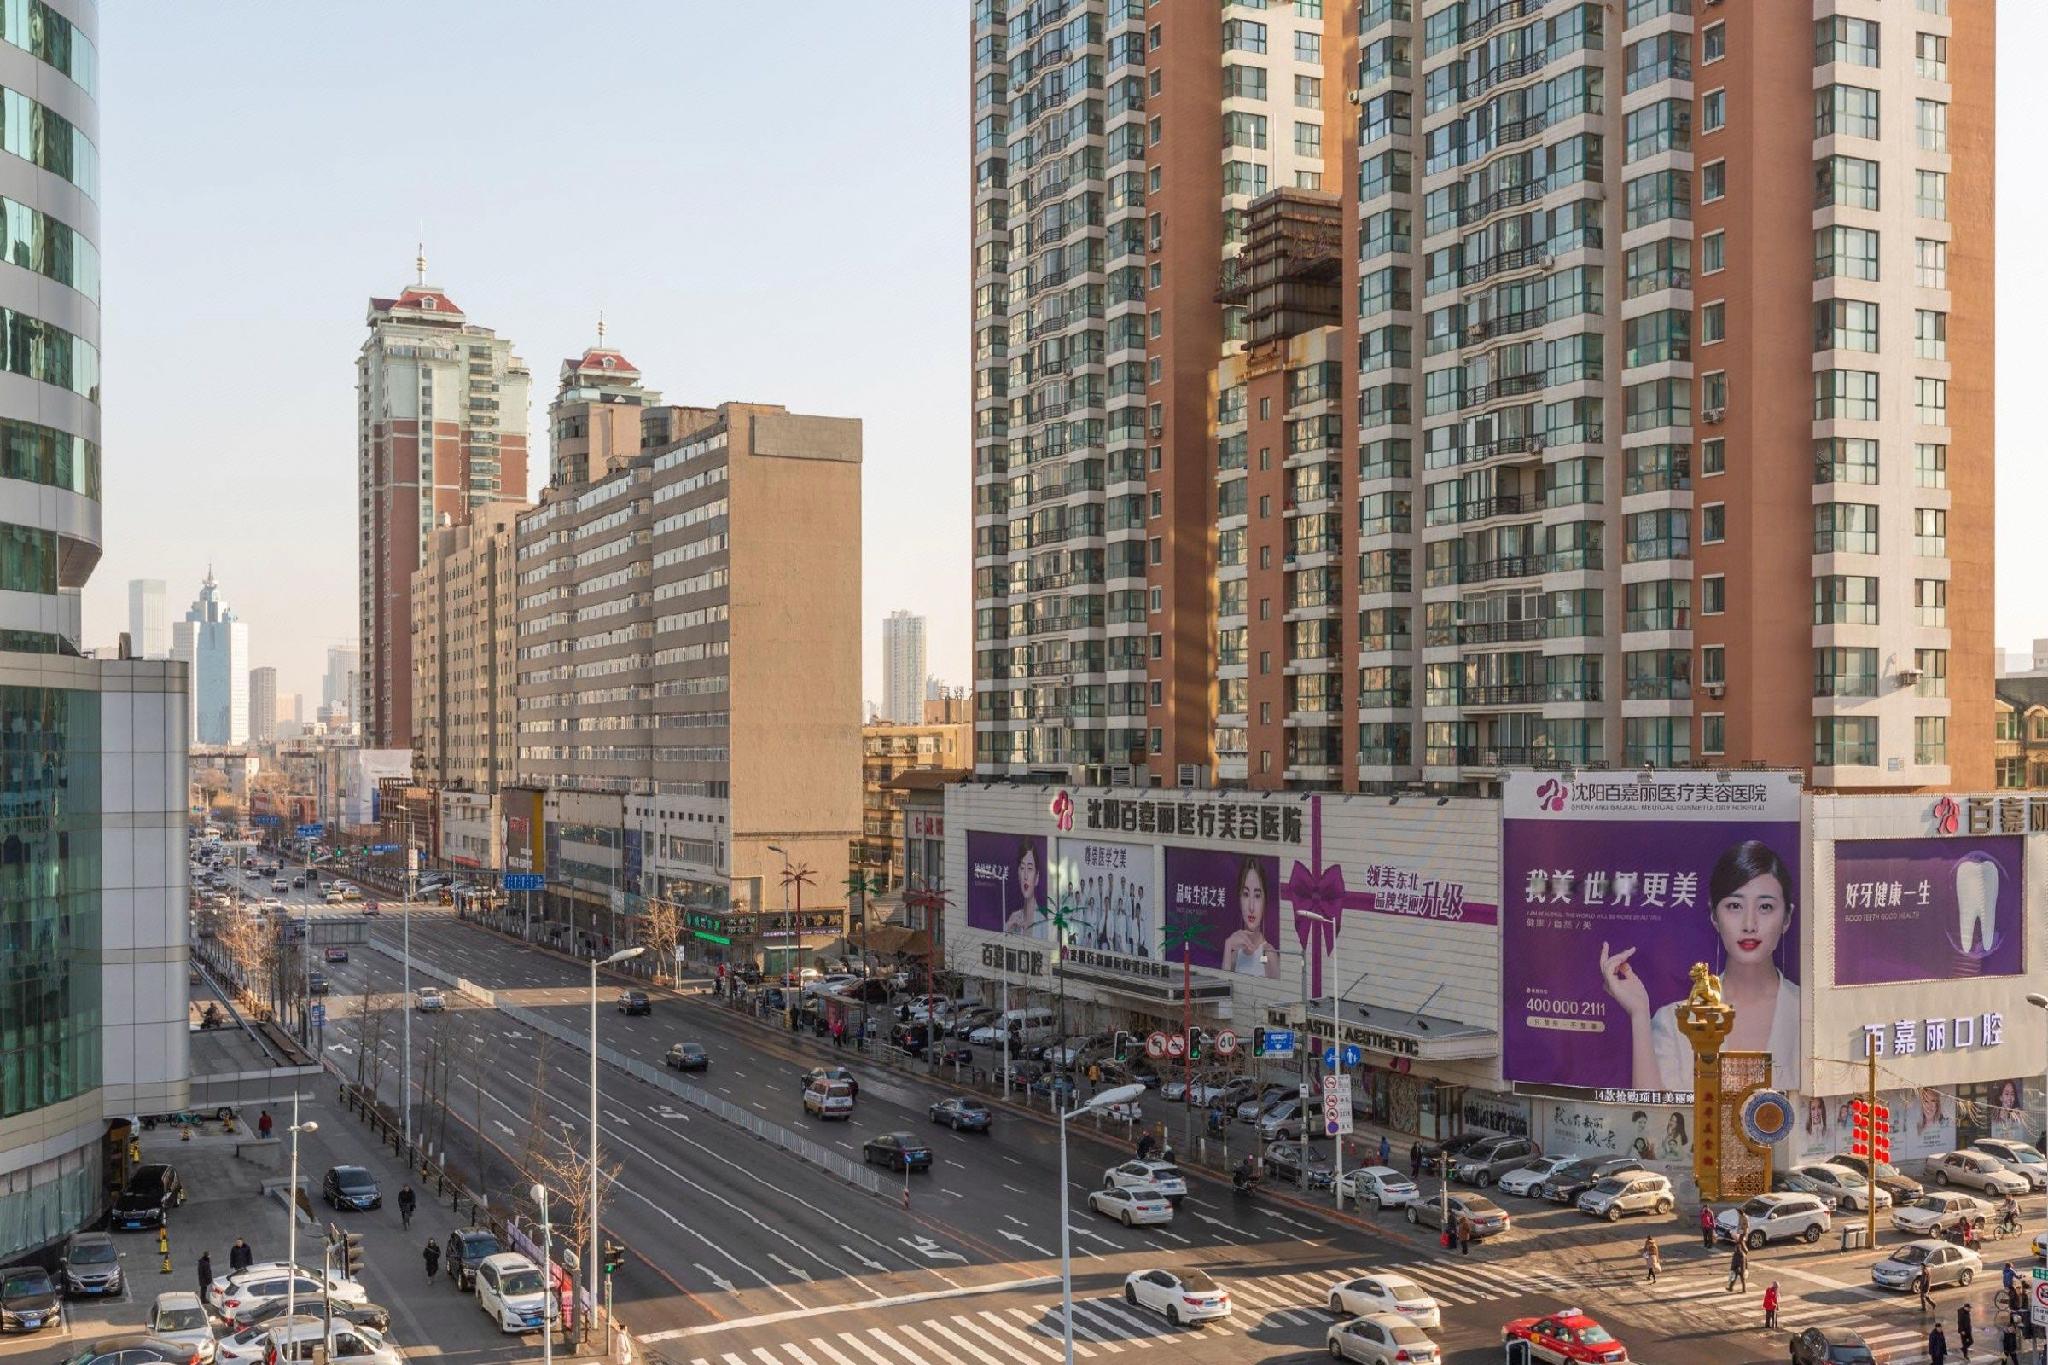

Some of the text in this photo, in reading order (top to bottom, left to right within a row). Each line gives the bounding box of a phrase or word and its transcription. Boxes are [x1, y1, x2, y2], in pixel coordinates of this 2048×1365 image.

[1571, 783, 1768, 802] 沈阳百嘉丽医疗美容医院
[1087, 798, 1302, 843] 沈阳百嘉丽医疗美容医院
[1176, 883, 1226, 907] 品味生活之美
[1421, 880, 1463, 918] 升级
[1583, 871, 1698, 908] 世界更美
[1845, 880, 1931, 909] 好牙健康一生
[1526, 998, 1606, 1017] 400 000 2111
[1220, 1035, 1234, 1048] 60
[1863, 1012, 2004, 1057] 百嘉丽口腔
